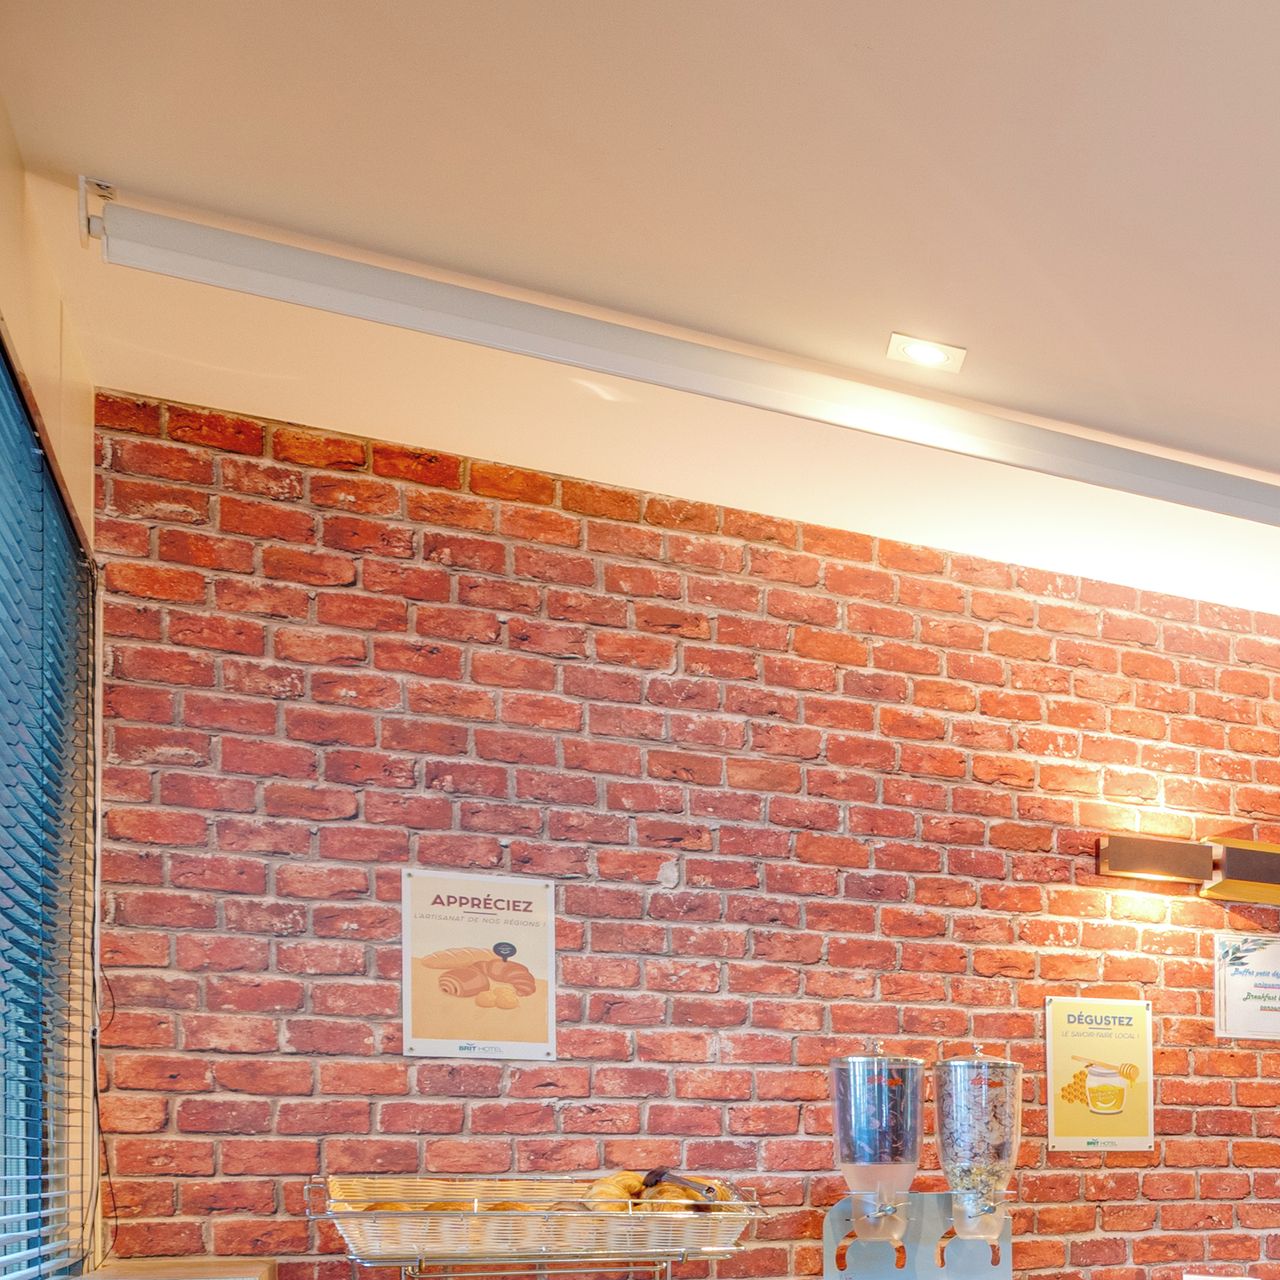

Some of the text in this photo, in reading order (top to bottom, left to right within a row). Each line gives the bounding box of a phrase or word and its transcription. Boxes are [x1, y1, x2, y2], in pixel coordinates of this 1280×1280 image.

[430, 893, 534, 913] APPRÉCIEZ
[468, 916, 480, 924] DE
[482, 917, 501, 925] NOS
[503, 918, 541, 928] RÉGIONS
[1231, 967, 1255, 977] Buffet
[1255, 970, 1271, 979] petit
[1242, 992, 1277, 1002] Breakfast
[1067, 1011, 1134, 1027] DÉGUSTEZ
